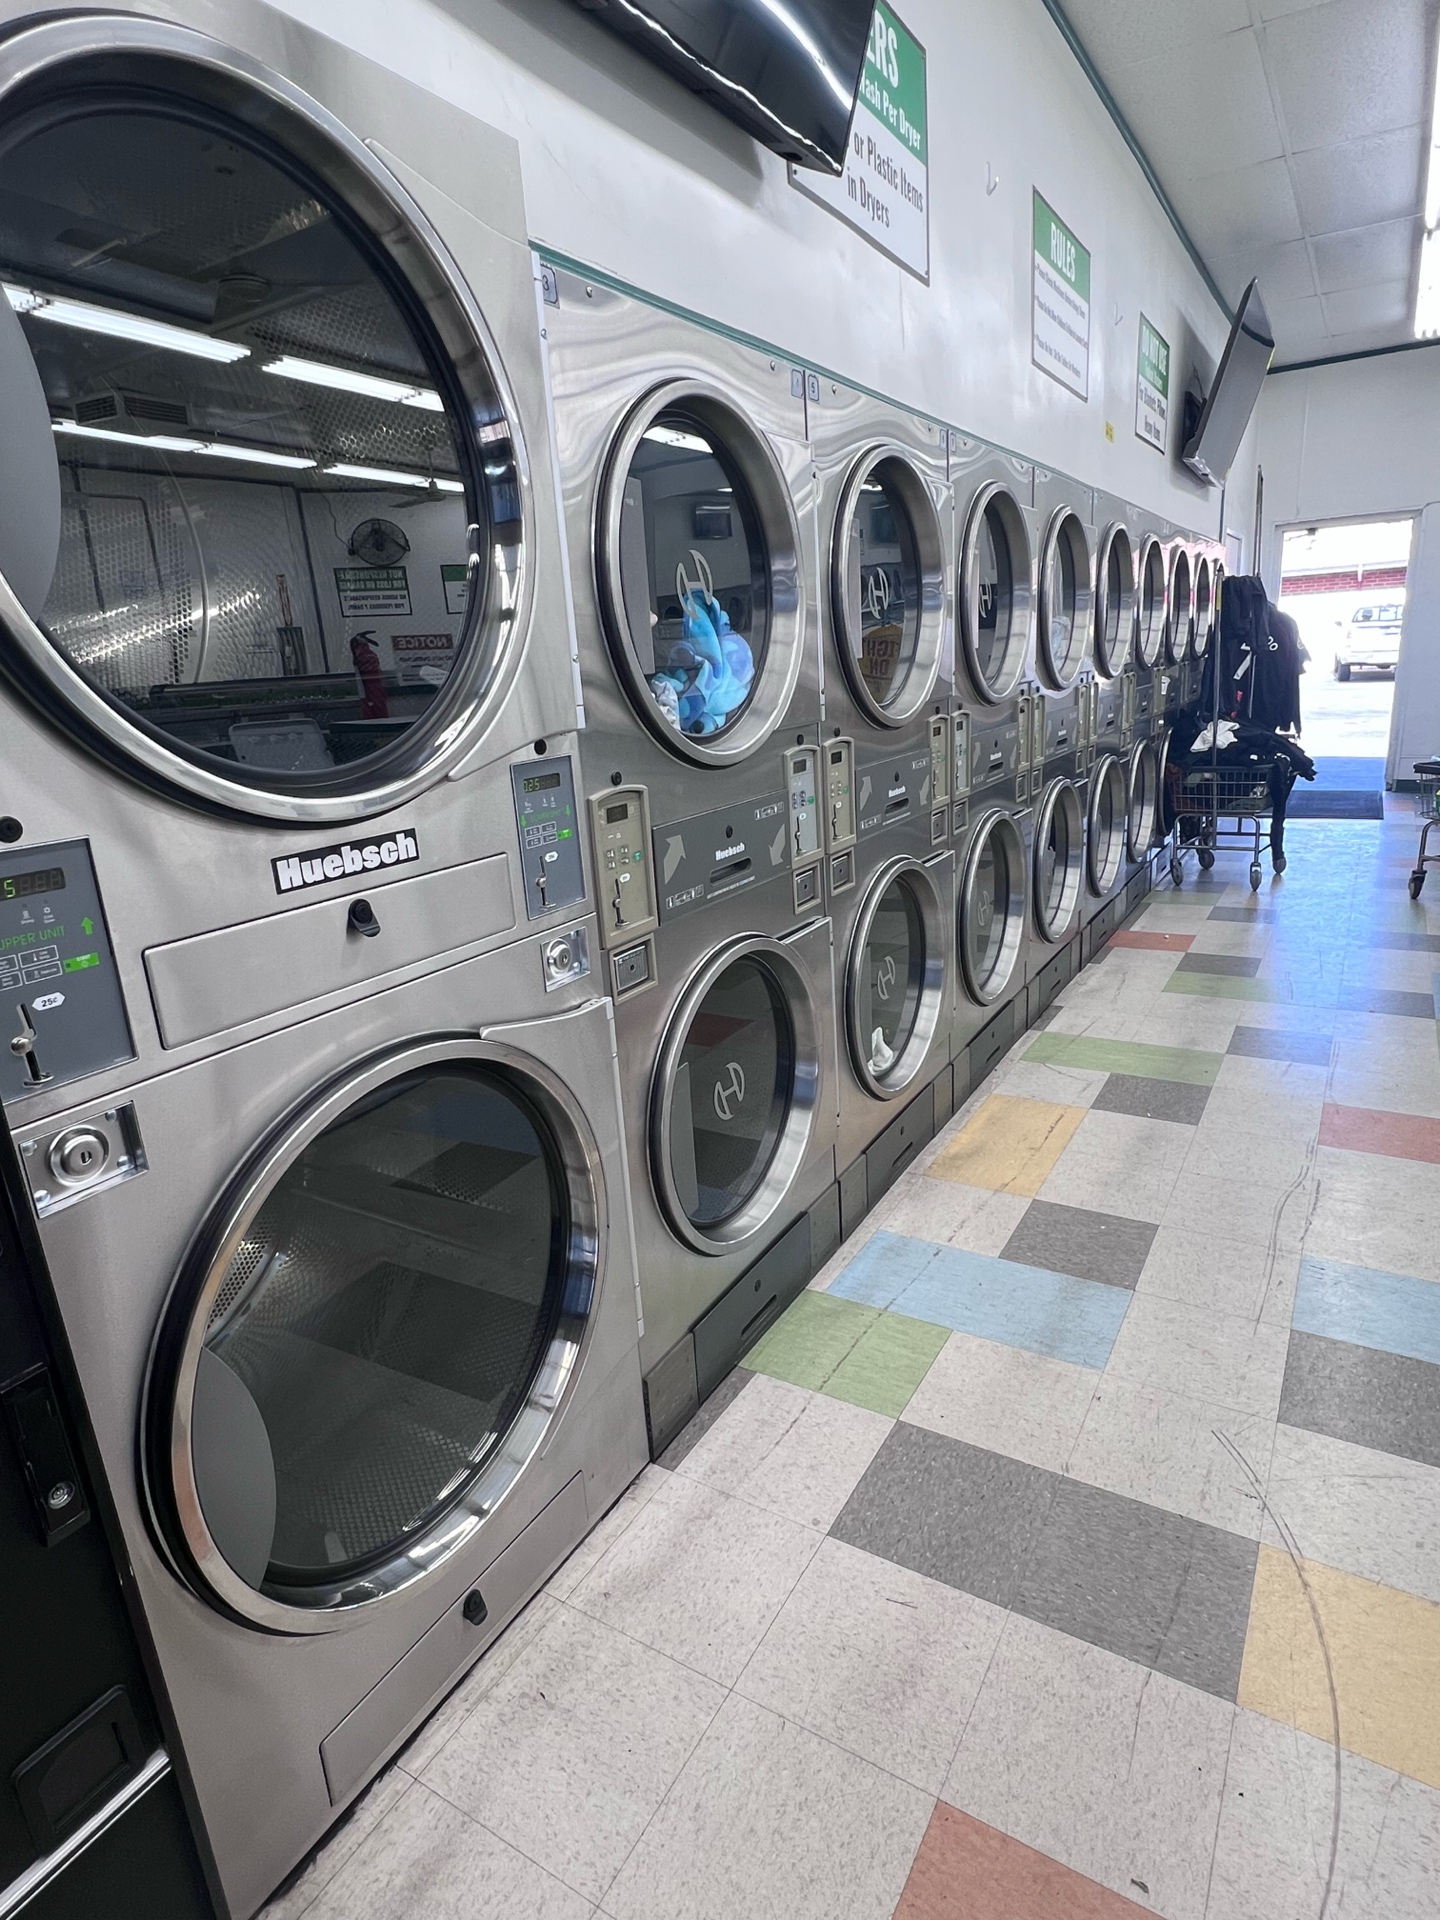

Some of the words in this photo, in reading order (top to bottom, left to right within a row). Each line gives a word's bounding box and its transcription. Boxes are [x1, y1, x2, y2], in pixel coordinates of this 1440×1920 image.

[882, 89, 898, 127] Per
[899, 107, 921, 150] Dryer
[854, 131, 864, 159] or
[867, 135, 898, 190] Plastic
[900, 167, 923, 213] Items
[847, 166, 857, 202] in
[860, 176, 890, 228] Dryers
[1050, 221, 1076, 282] RULES
[542, 274, 550, 291] 3
[811, 381, 816, 393] 5
[276, 832, 418, 891] Huebsch
[715, 842, 746, 861] Huebsch
[0, 932, 36, 951] UPPER
[39, 925, 65, 940] UNIT
[41, 996, 58, 1007] 25¢
